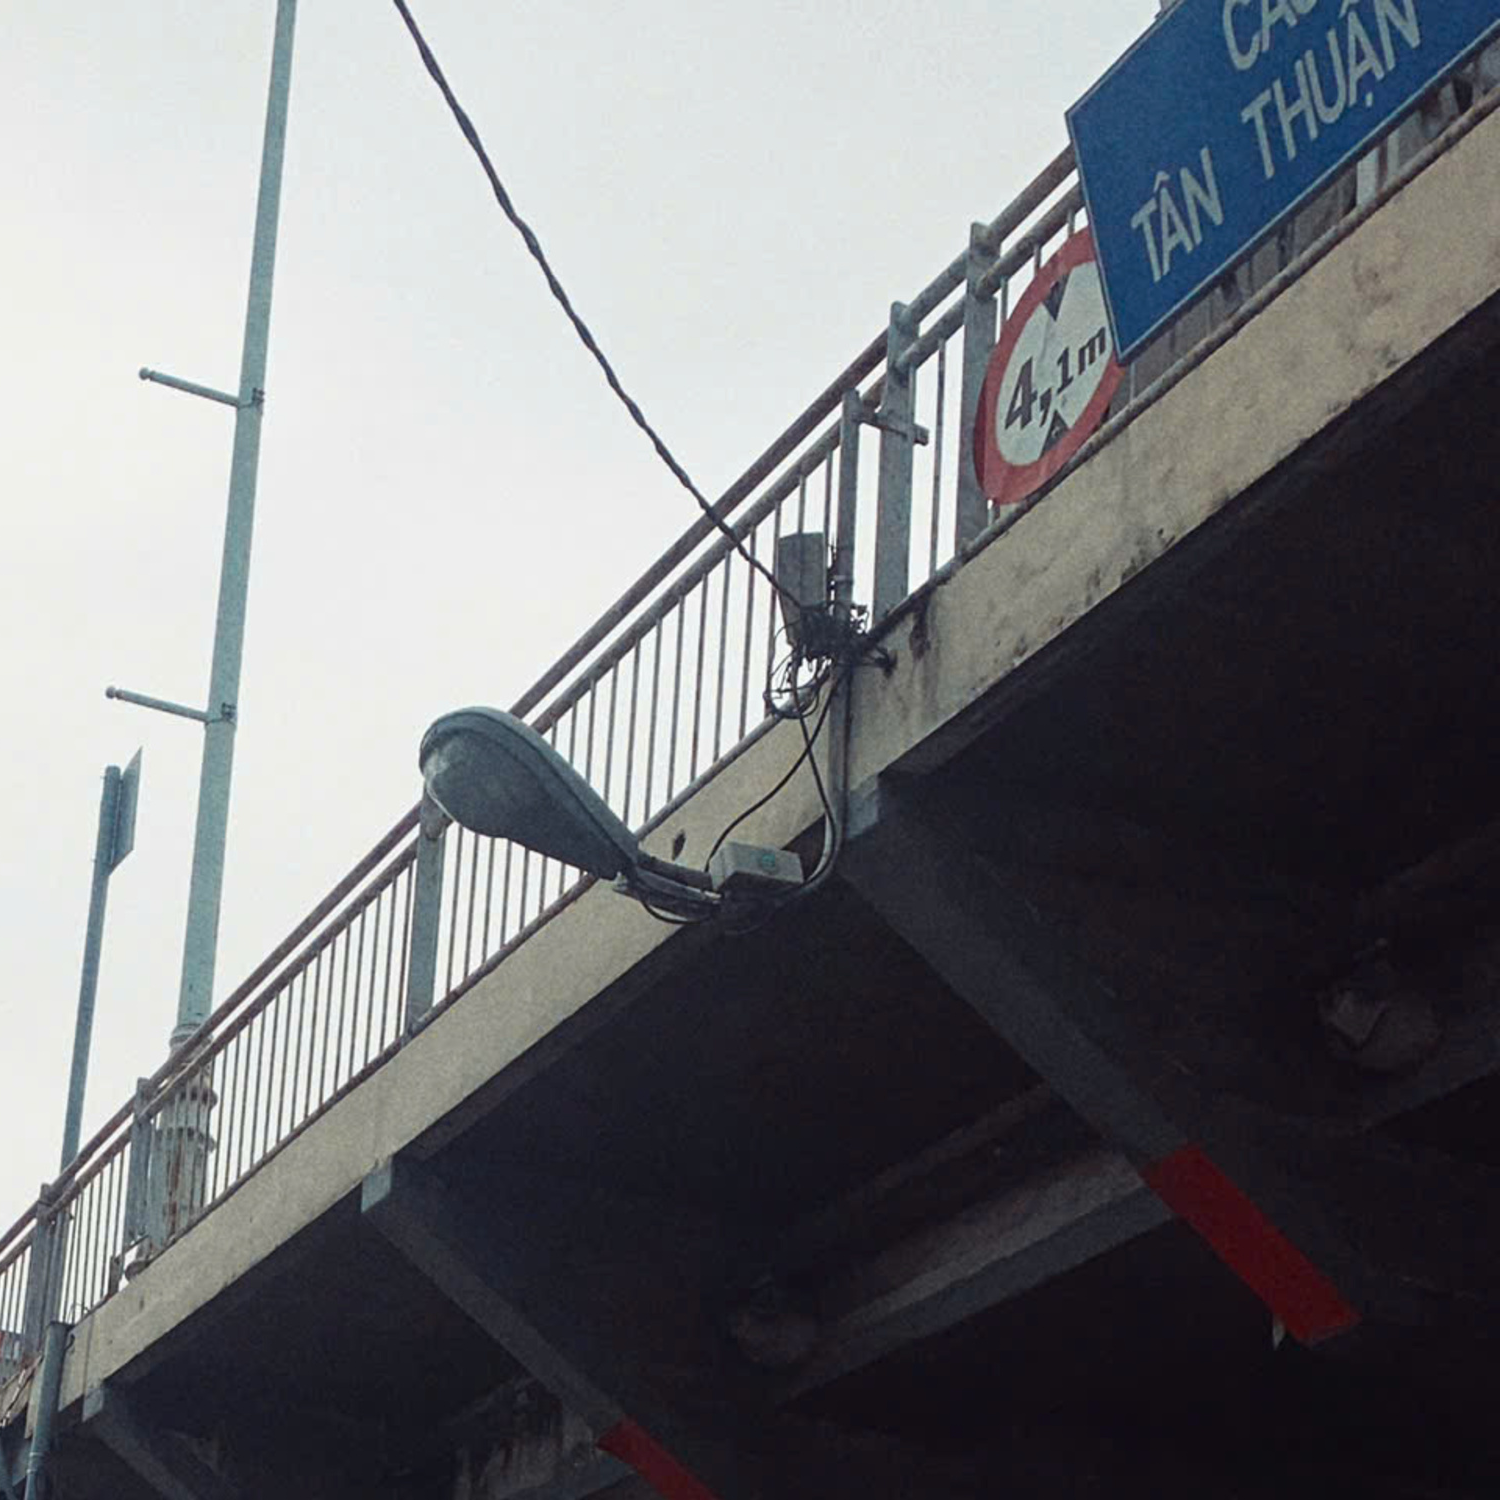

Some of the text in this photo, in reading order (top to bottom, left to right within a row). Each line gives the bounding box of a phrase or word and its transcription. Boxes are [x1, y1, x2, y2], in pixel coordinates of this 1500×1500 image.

[1131, 0, 1421, 283] TÂN THUẬN
[1004, 326, 1107, 431] 4,1m
